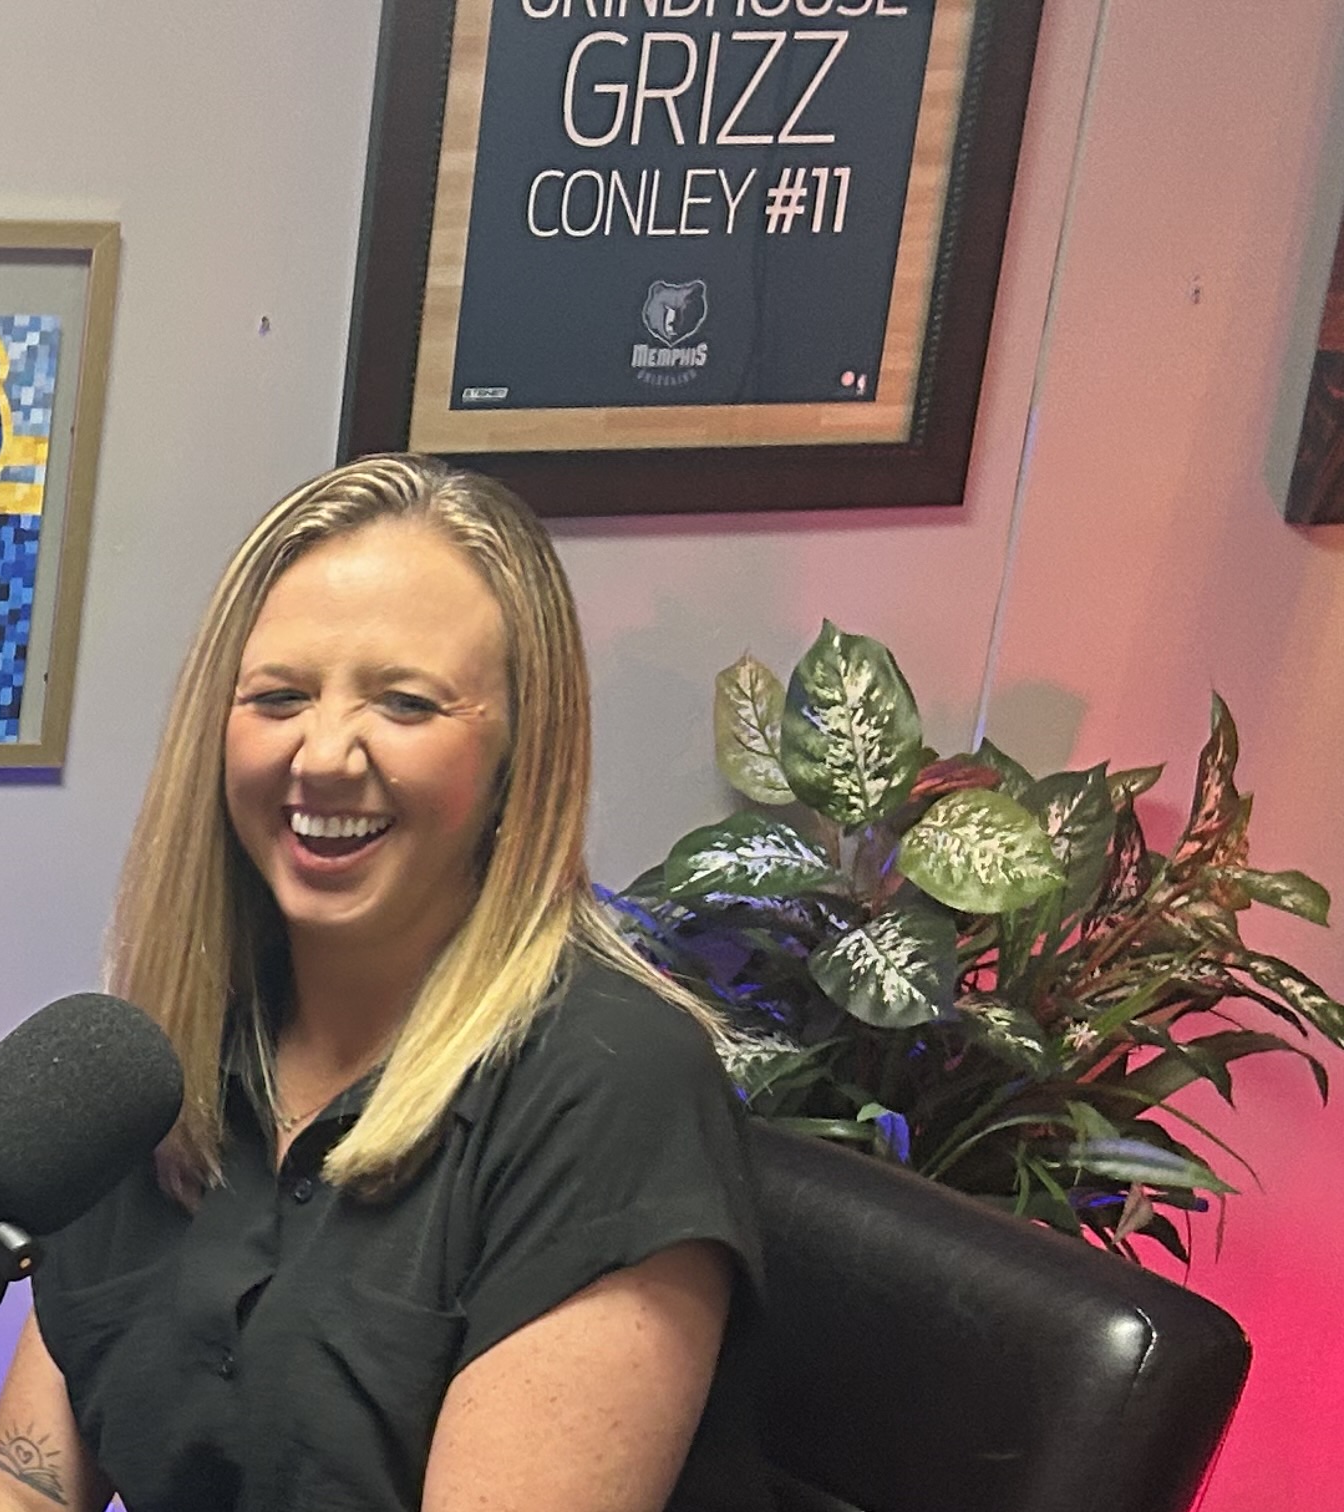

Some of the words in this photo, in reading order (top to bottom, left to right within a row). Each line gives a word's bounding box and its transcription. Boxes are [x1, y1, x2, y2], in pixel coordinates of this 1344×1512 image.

[562, 30, 850, 147] GRIZZ
[527, 168, 757, 237] CONLEY
[765, 166, 851, 235] #11
